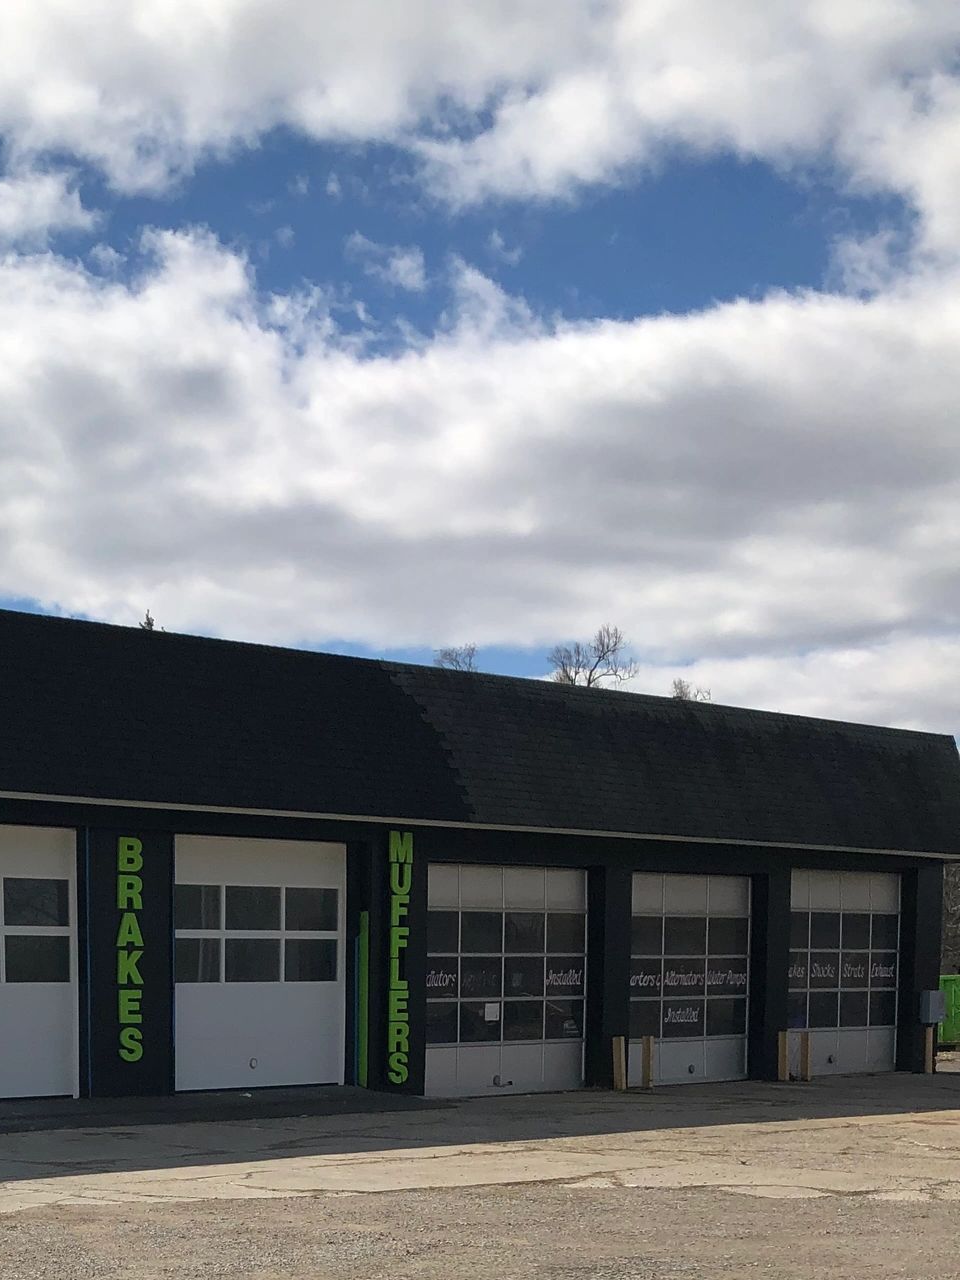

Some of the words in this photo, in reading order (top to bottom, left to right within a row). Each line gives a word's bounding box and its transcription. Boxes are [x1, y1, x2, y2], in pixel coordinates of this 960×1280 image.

[116, 836, 145, 1063] BRAKES
[388, 831, 414, 1084] MUFFLERS
[426, 970, 457, 987] diators
[787, 964, 805, 978] akes
[811, 963, 836, 978] Shocks
[843, 963, 865, 978] Struts
[630, 972, 656, 986] arters
[664, 1007, 700, 1023] Installed
